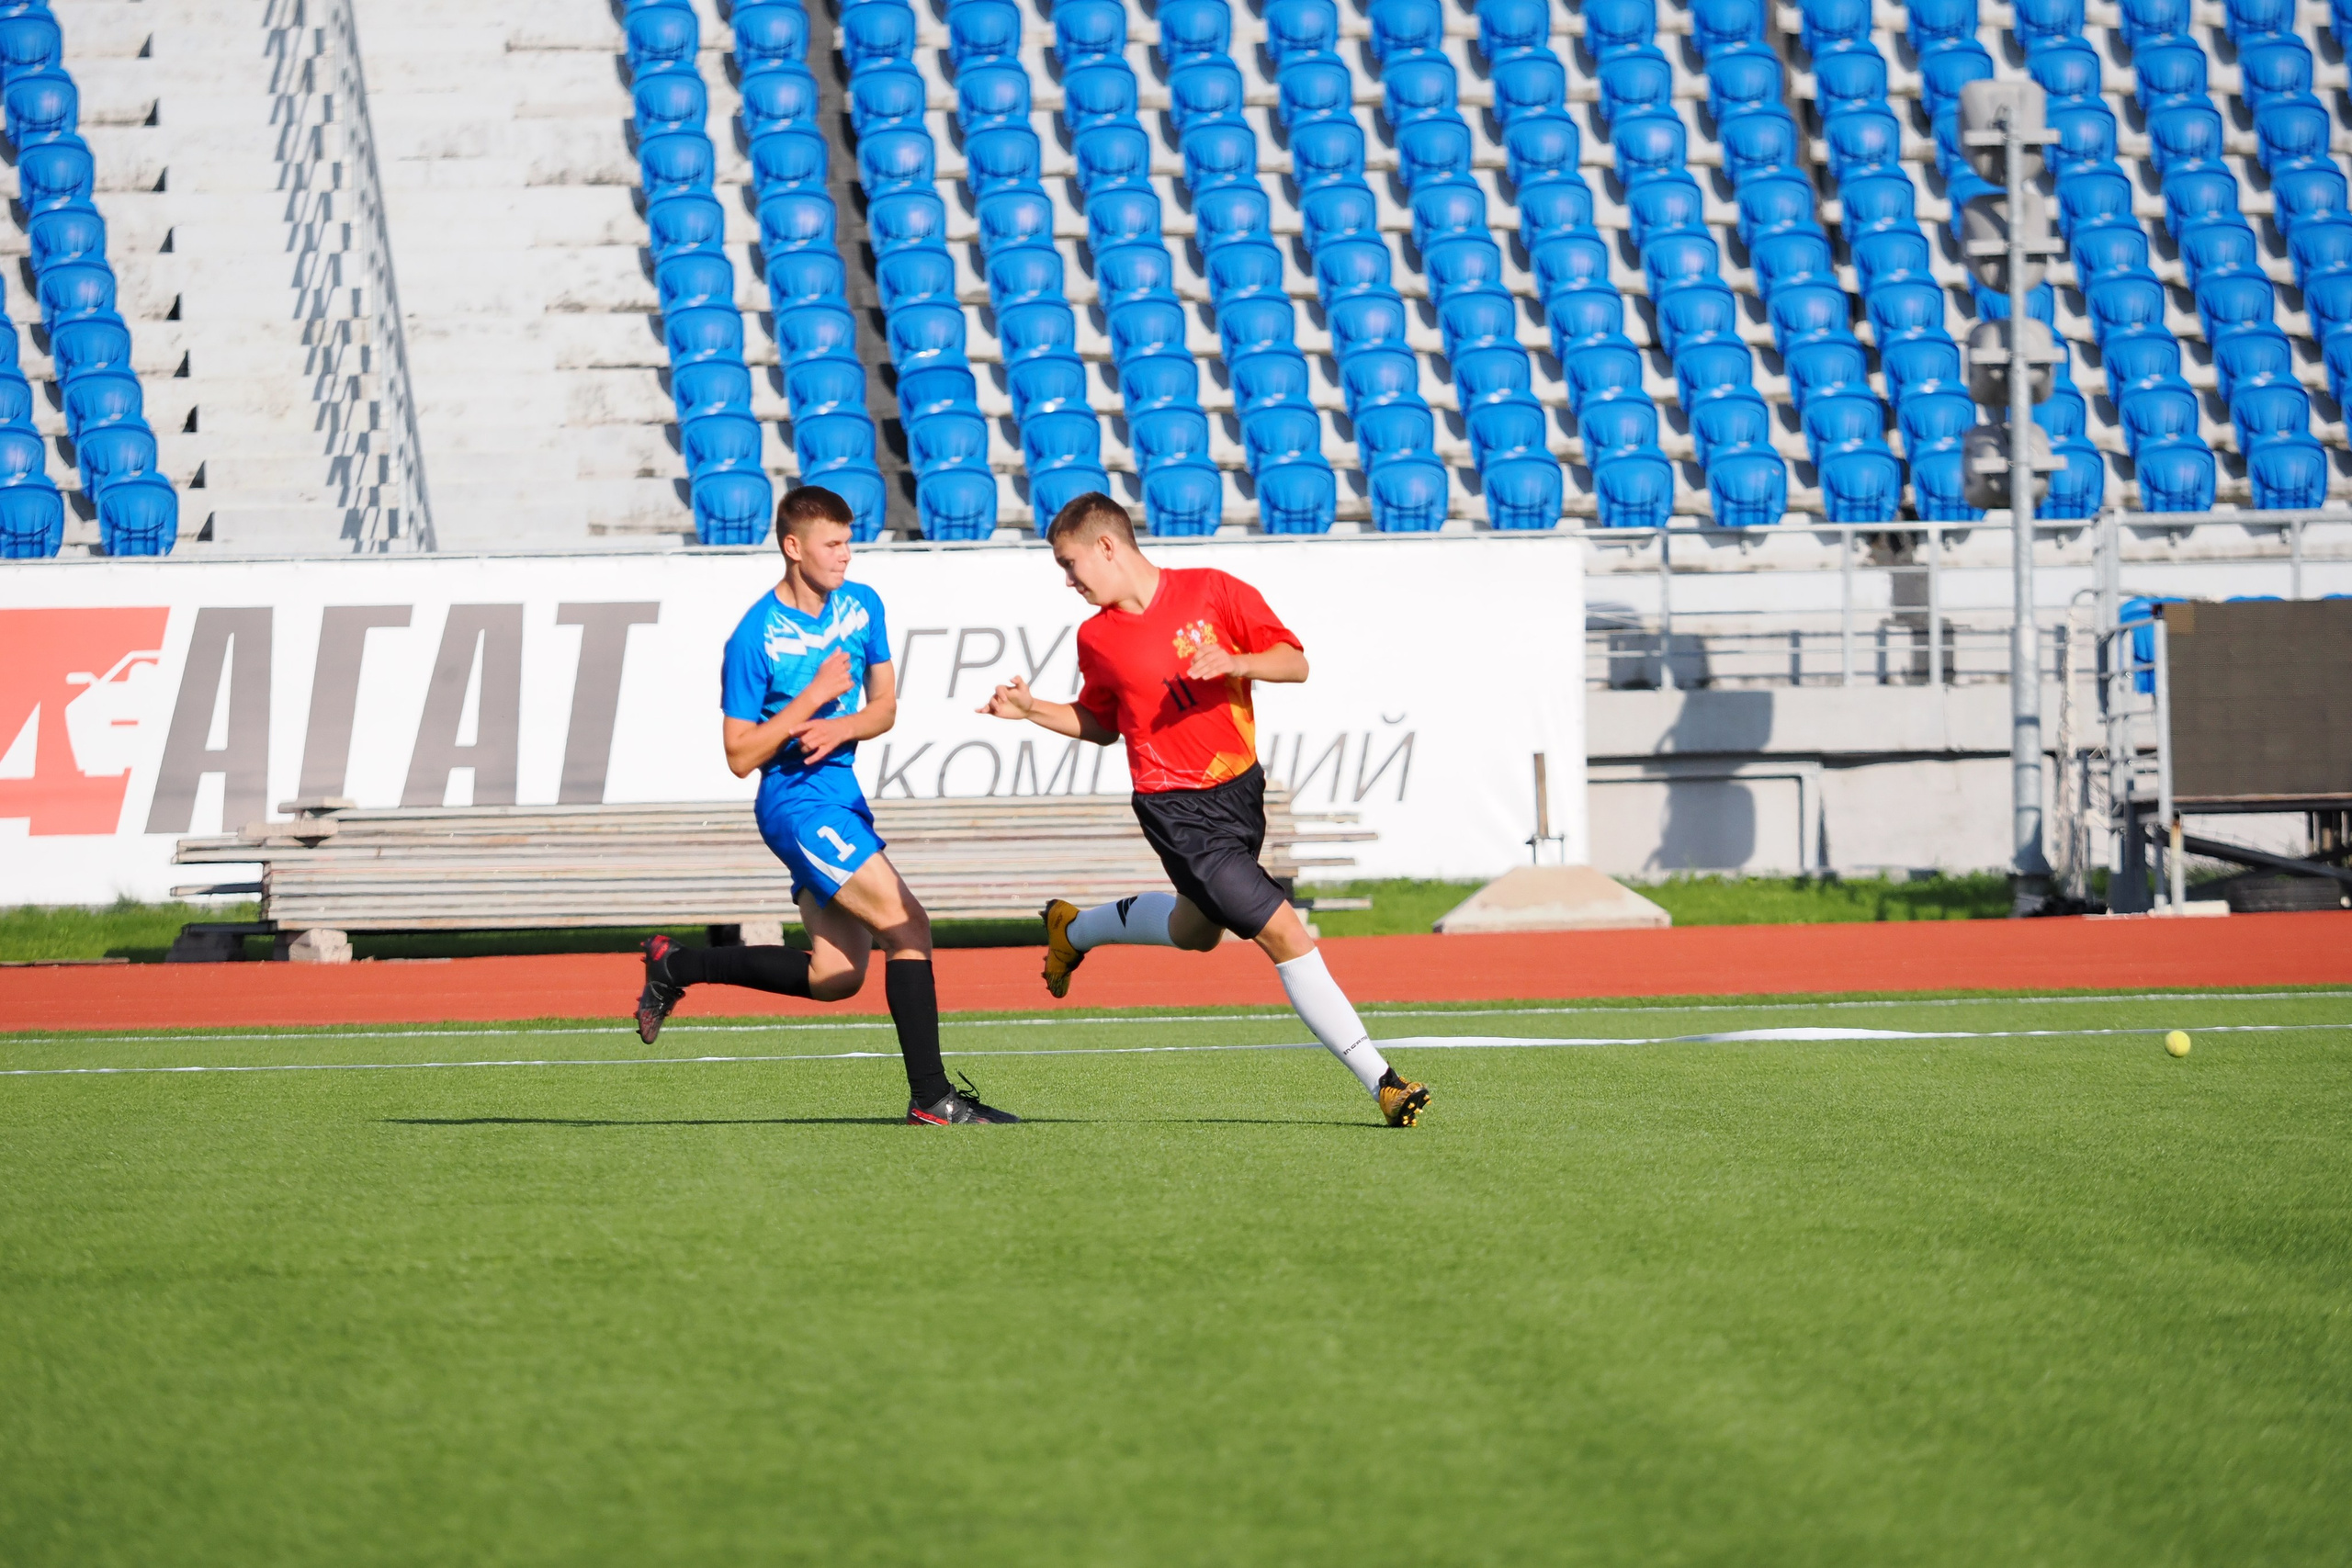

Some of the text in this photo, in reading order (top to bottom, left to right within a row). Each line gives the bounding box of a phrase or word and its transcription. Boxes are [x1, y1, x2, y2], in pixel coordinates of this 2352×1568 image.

[1161, 673, 1198, 711] 11
[143, 602, 661, 835] АГАТ
[816, 825, 857, 863] 1
